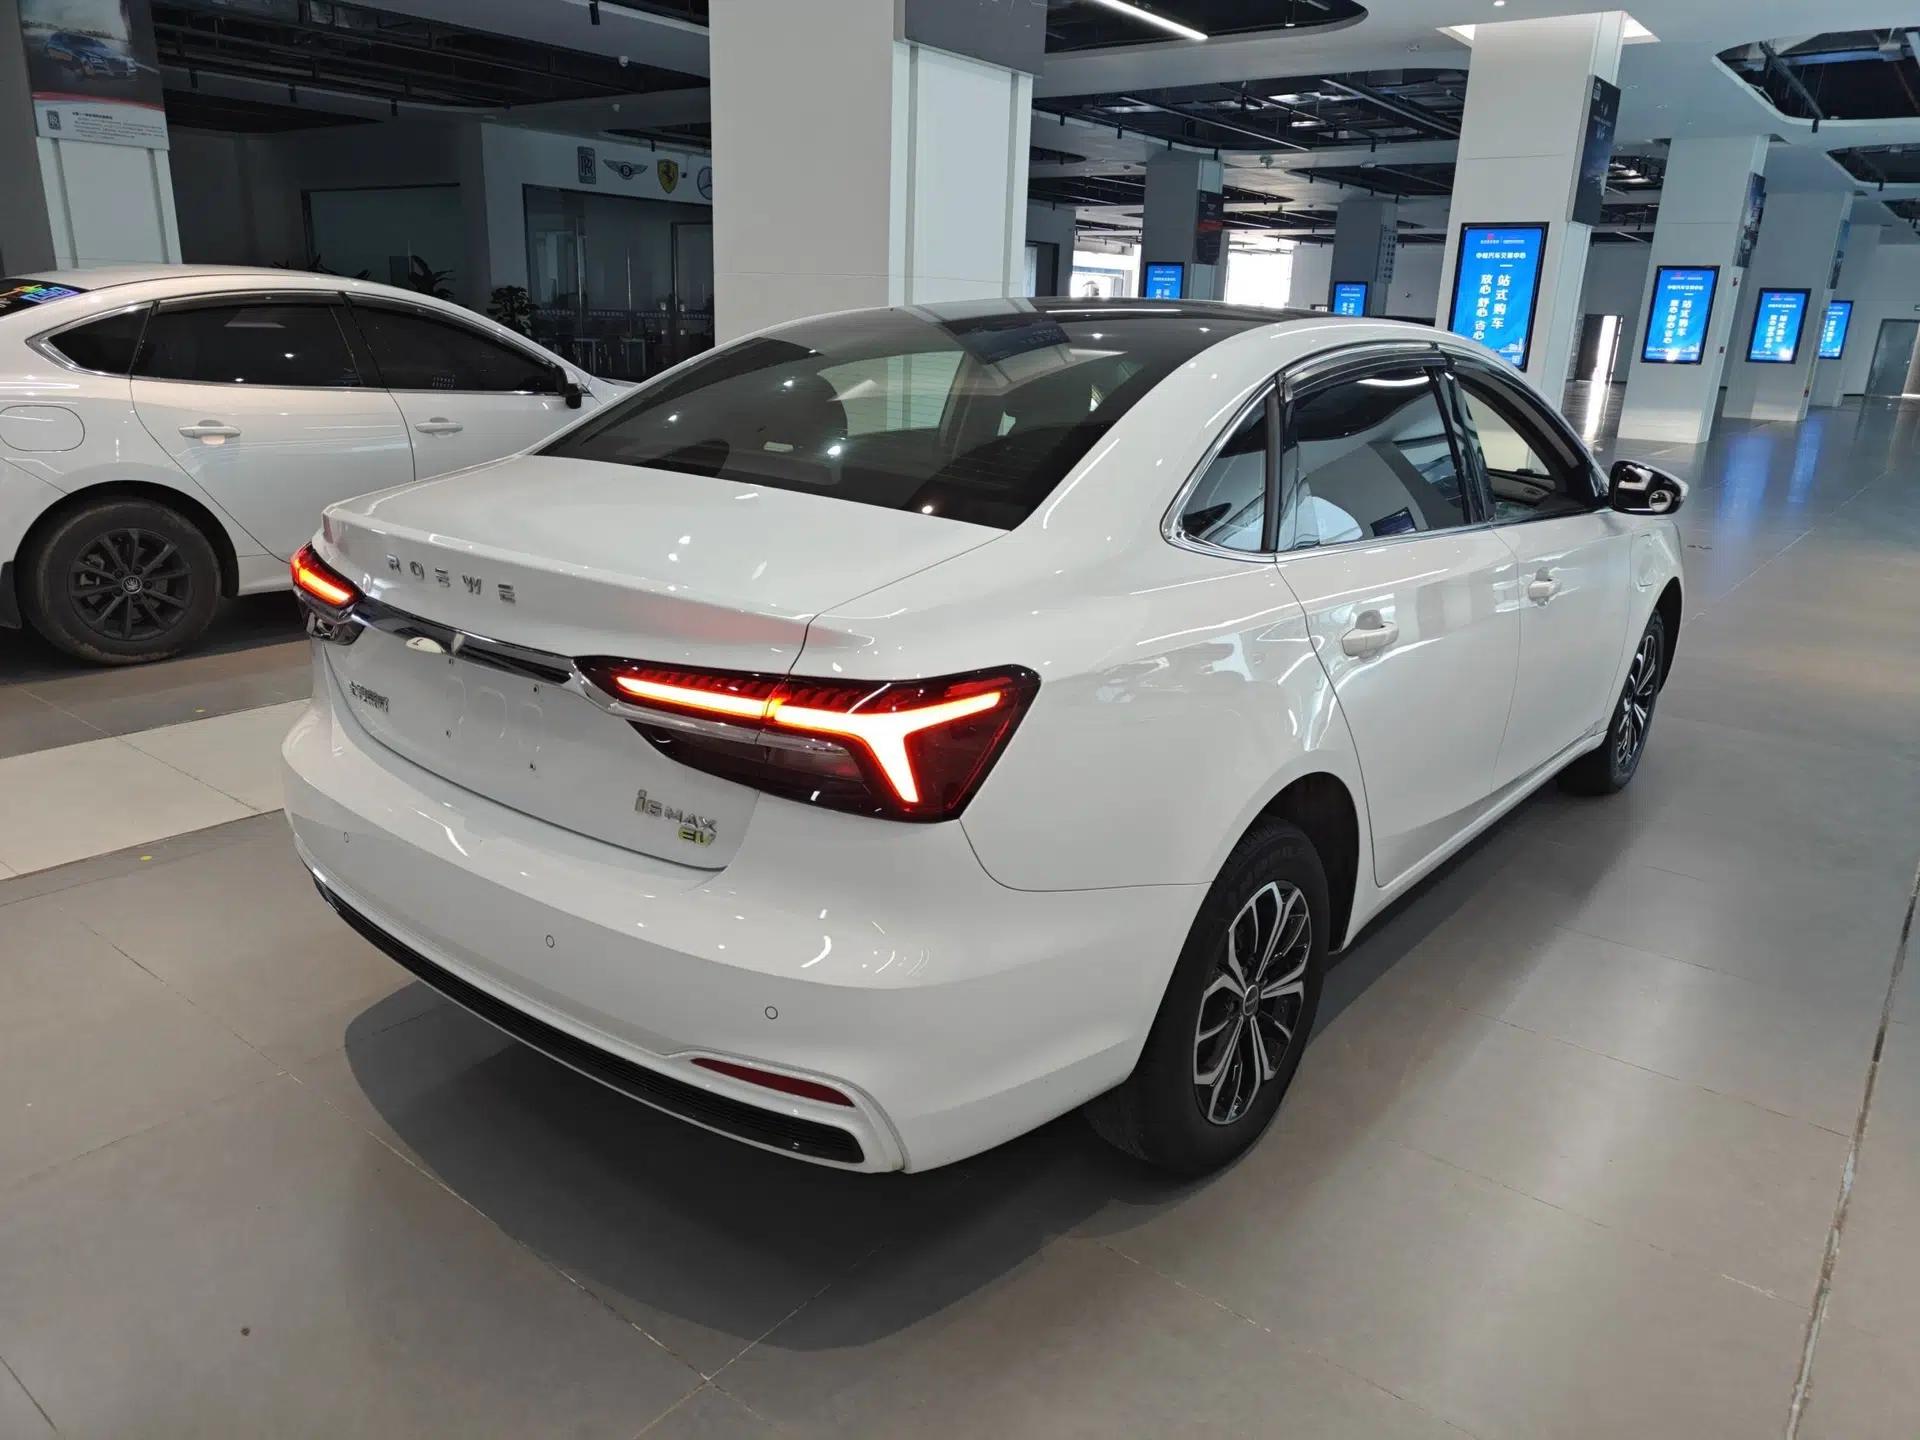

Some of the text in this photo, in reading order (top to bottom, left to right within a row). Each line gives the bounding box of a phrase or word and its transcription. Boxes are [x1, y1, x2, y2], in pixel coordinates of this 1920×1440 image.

[386, 552, 516, 604] ROEWE
[664, 806, 718, 834] MAX
[678, 825, 718, 849] EV
